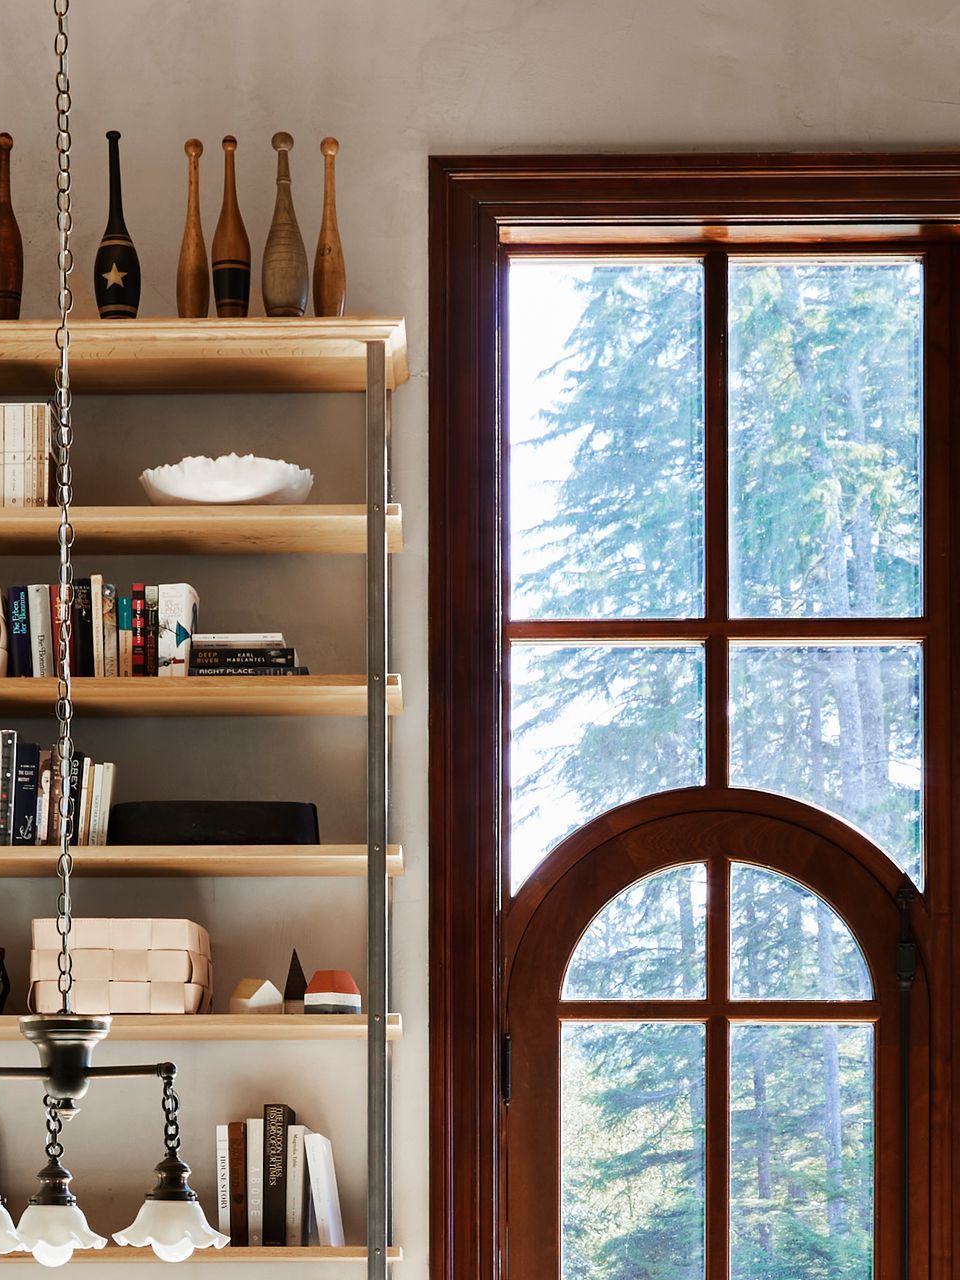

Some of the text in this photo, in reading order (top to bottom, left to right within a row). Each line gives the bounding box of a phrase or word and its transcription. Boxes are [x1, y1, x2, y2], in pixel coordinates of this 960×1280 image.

[71, 759, 79, 790] GREY
[269, 1136, 276, 1146] OF
[220, 1155, 228, 1209] HOUSE STORY
[269, 1164, 277, 1186] TIMES
[251, 1167, 261, 1217] ABODE
